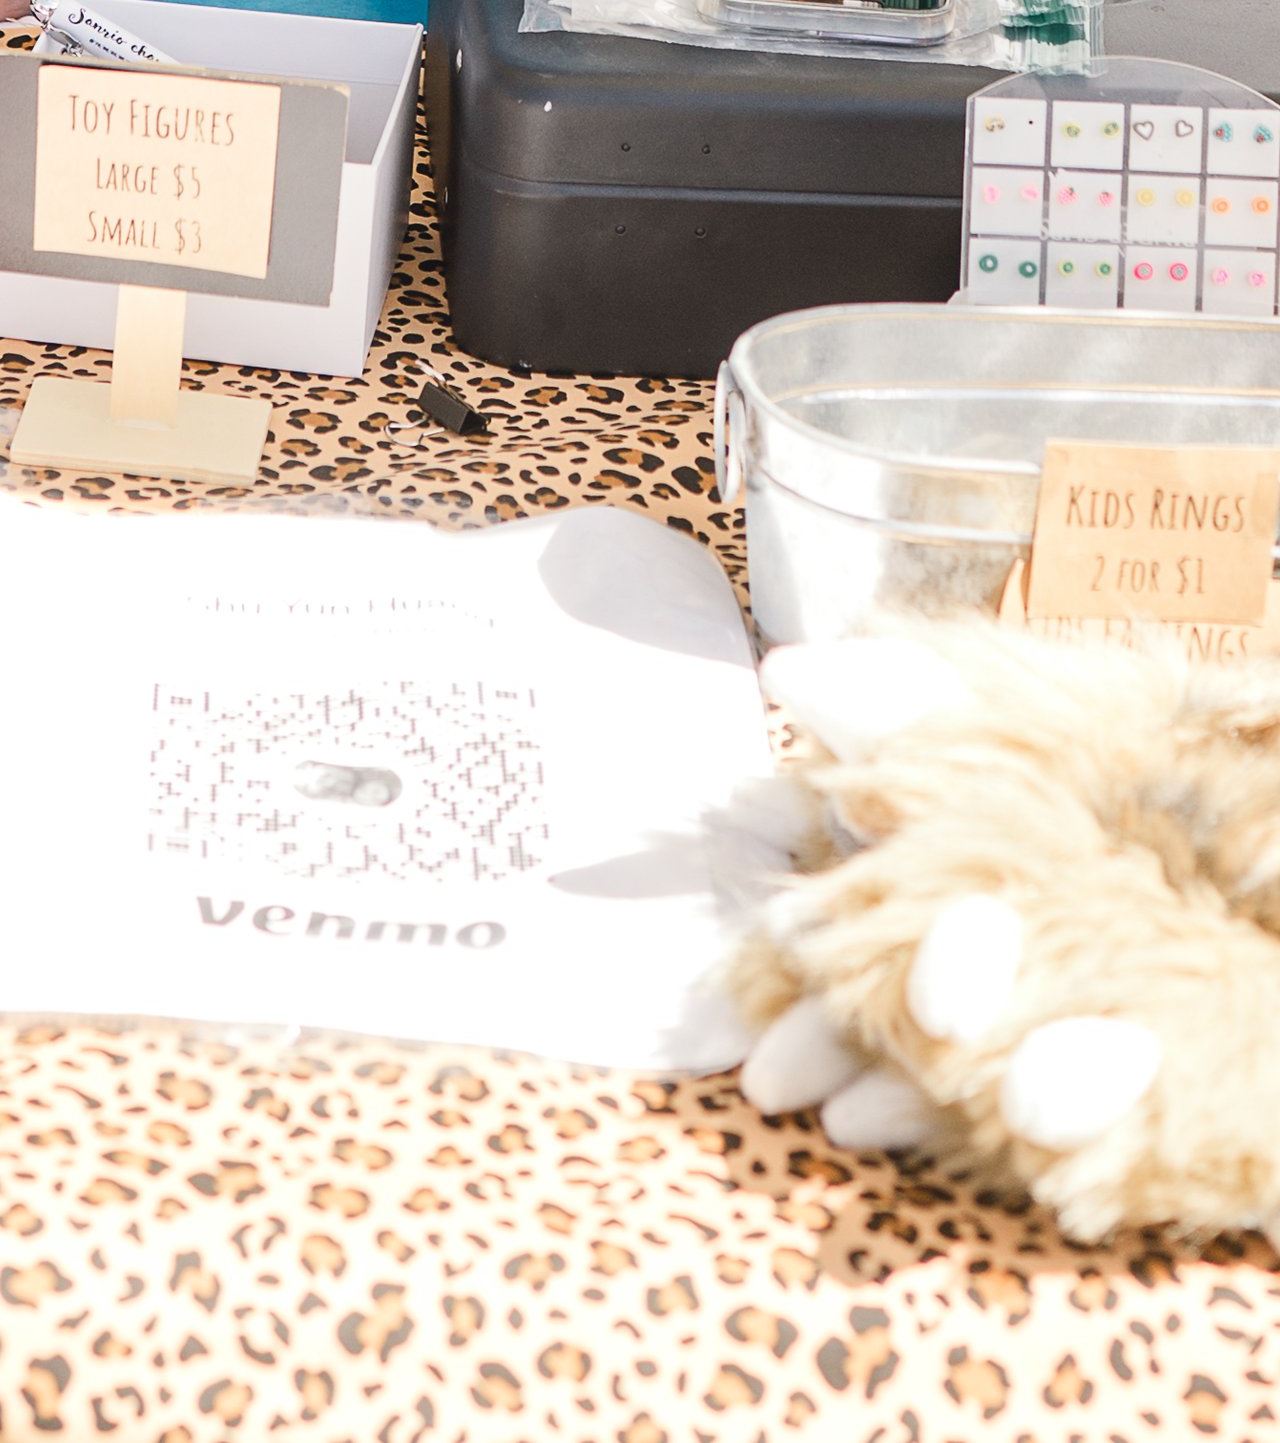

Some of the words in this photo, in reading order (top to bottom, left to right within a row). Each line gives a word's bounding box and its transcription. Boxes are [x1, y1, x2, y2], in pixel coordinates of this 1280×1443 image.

[172, 162, 202, 201] $5
[173, 217, 203, 255] $3
[1065, 483, 1135, 530] KIDS
[1150, 487, 1247, 534] RINGS
[1089, 552, 1107, 592] 2
[195, 895, 507, 950] venmo
